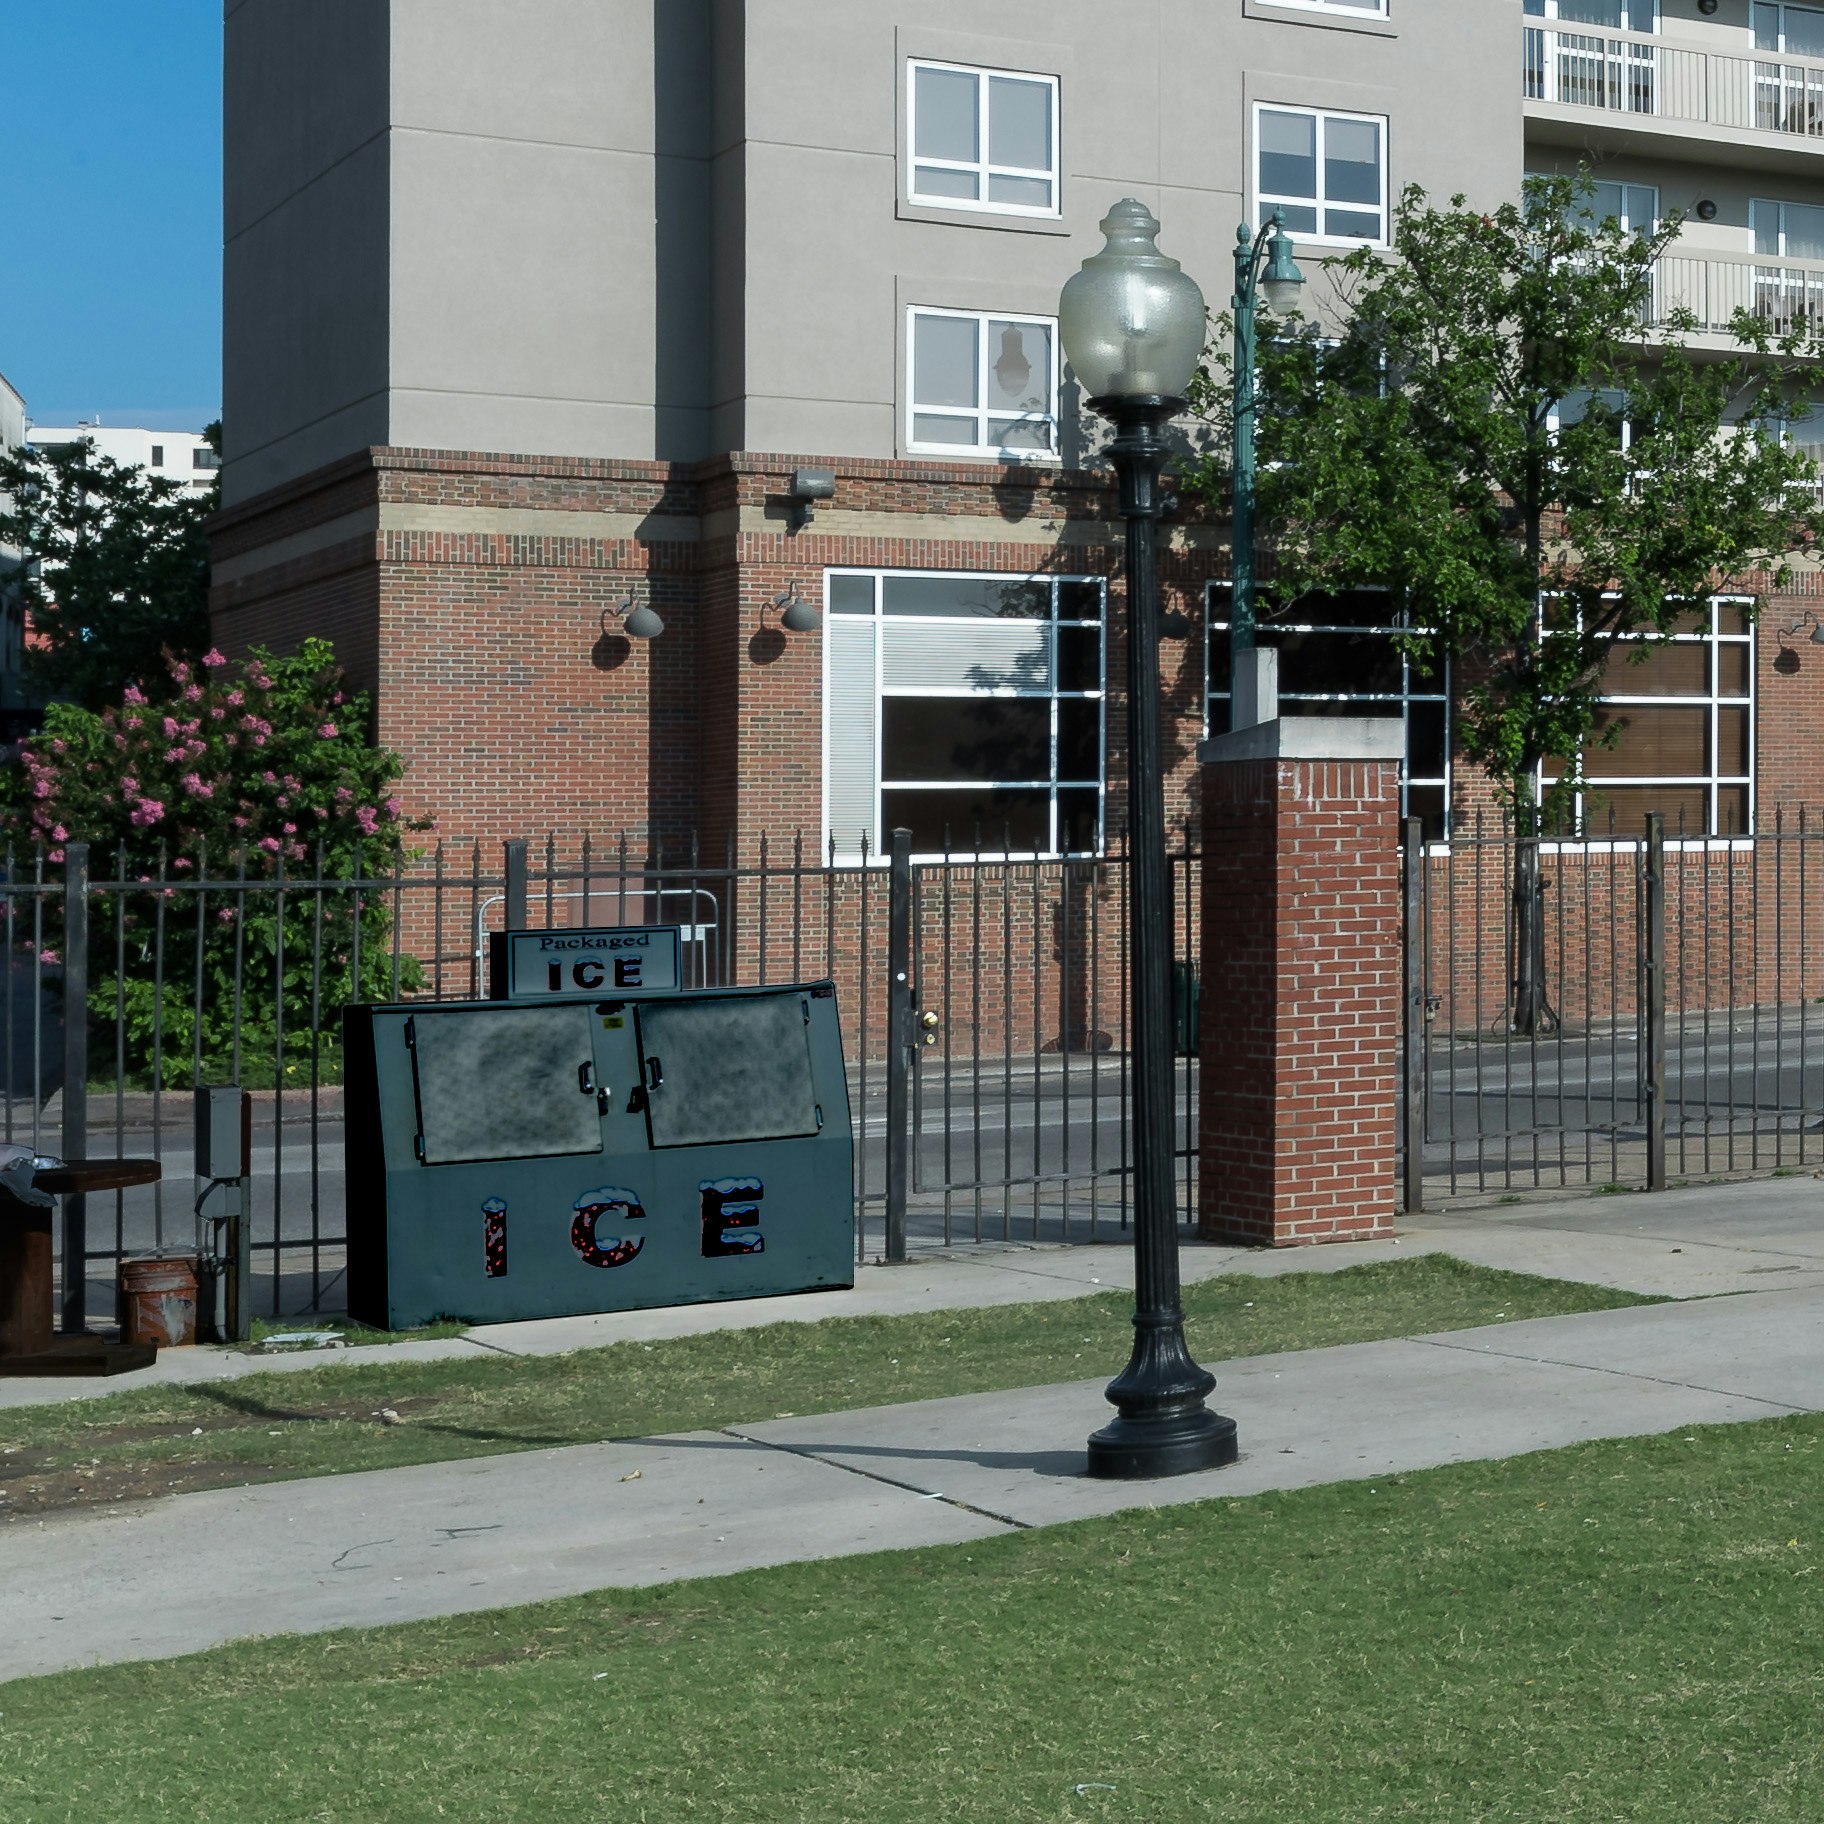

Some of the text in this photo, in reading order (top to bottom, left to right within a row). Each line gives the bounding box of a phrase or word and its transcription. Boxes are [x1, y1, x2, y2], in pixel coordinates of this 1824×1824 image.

[540, 933, 650, 951] Packaged
[548, 954, 643, 991] ICE
[480, 1176, 765, 1279] ICE
